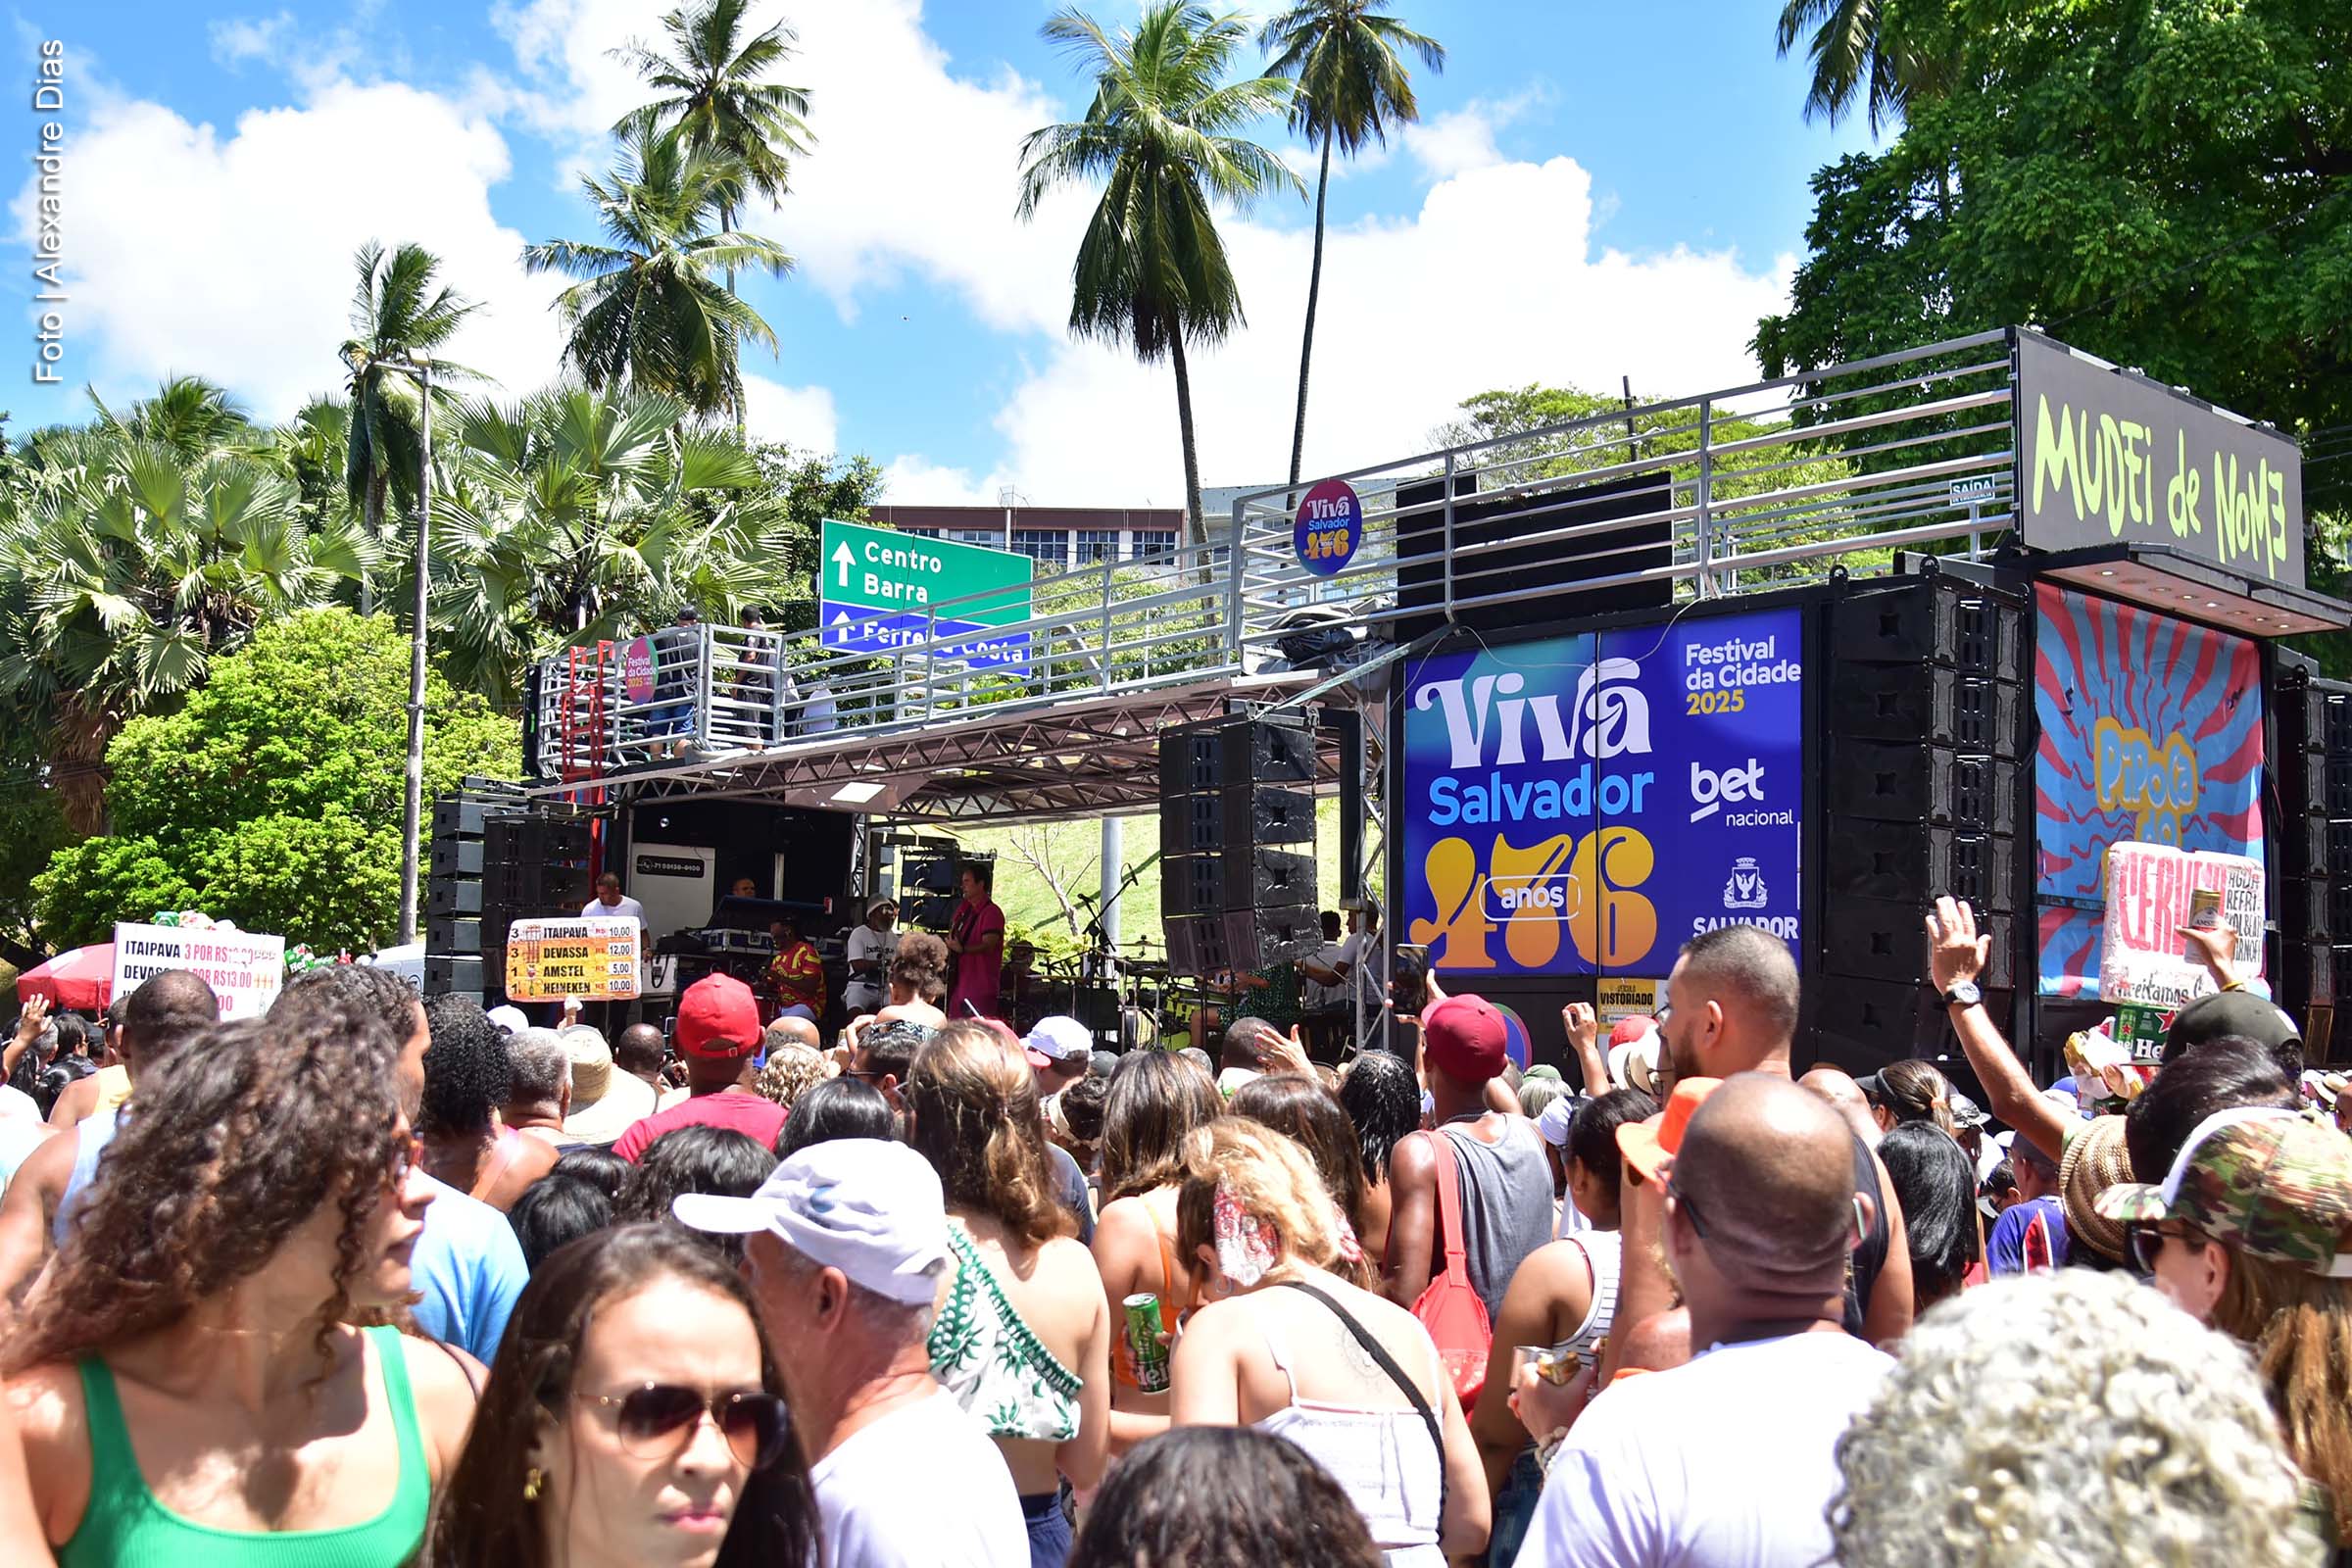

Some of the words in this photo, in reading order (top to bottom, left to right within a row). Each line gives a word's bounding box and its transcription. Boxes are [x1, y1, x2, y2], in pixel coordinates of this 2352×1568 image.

[1952, 478, 1991, 494] SAÍDA
[1307, 496, 1349, 518] Viva
[1308, 517, 1349, 530] Salvador
[1303, 528, 1349, 560] 476
[864, 541, 942, 573] Centro
[863, 572, 929, 604] Barra
[1686, 635, 1775, 666] Festival
[628, 656, 652, 668] Festival
[628, 667, 636, 677] da
[636, 666, 657, 676] Cidade
[627, 677, 643, 688] 2025
[1686, 667, 1714, 690] da
[1718, 659, 1801, 688] Cidade
[1687, 689, 1744, 715] 2025
[1415, 658, 1652, 769] Viva
[1690, 758, 1764, 804] bet
[1428, 762, 1654, 826] Salvador
[1726, 808, 1793, 827] nacional
[1409, 826, 1657, 968] 476
[1500, 885, 1565, 909] anos
[511, 928, 519, 938] 3
[543, 927, 588, 939] ITAIPAVA
[610, 926, 630, 937] 10,00
[125, 940, 180, 957] ITAIPAVA
[184, 943, 191, 960] 3
[193, 944, 212, 961] POR
[511, 948, 519, 958] 3
[543, 947, 589, 958] DEVASSA
[610, 944, 630, 956] 12,00
[511, 966, 518, 977] 1
[543, 965, 584, 977] AMSTEL
[612, 963, 629, 974] 5,00
[543, 981, 591, 994] HEINEKEN
[610, 980, 630, 991] 10,00
[1600, 993, 1652, 1004] VISTORIADO
